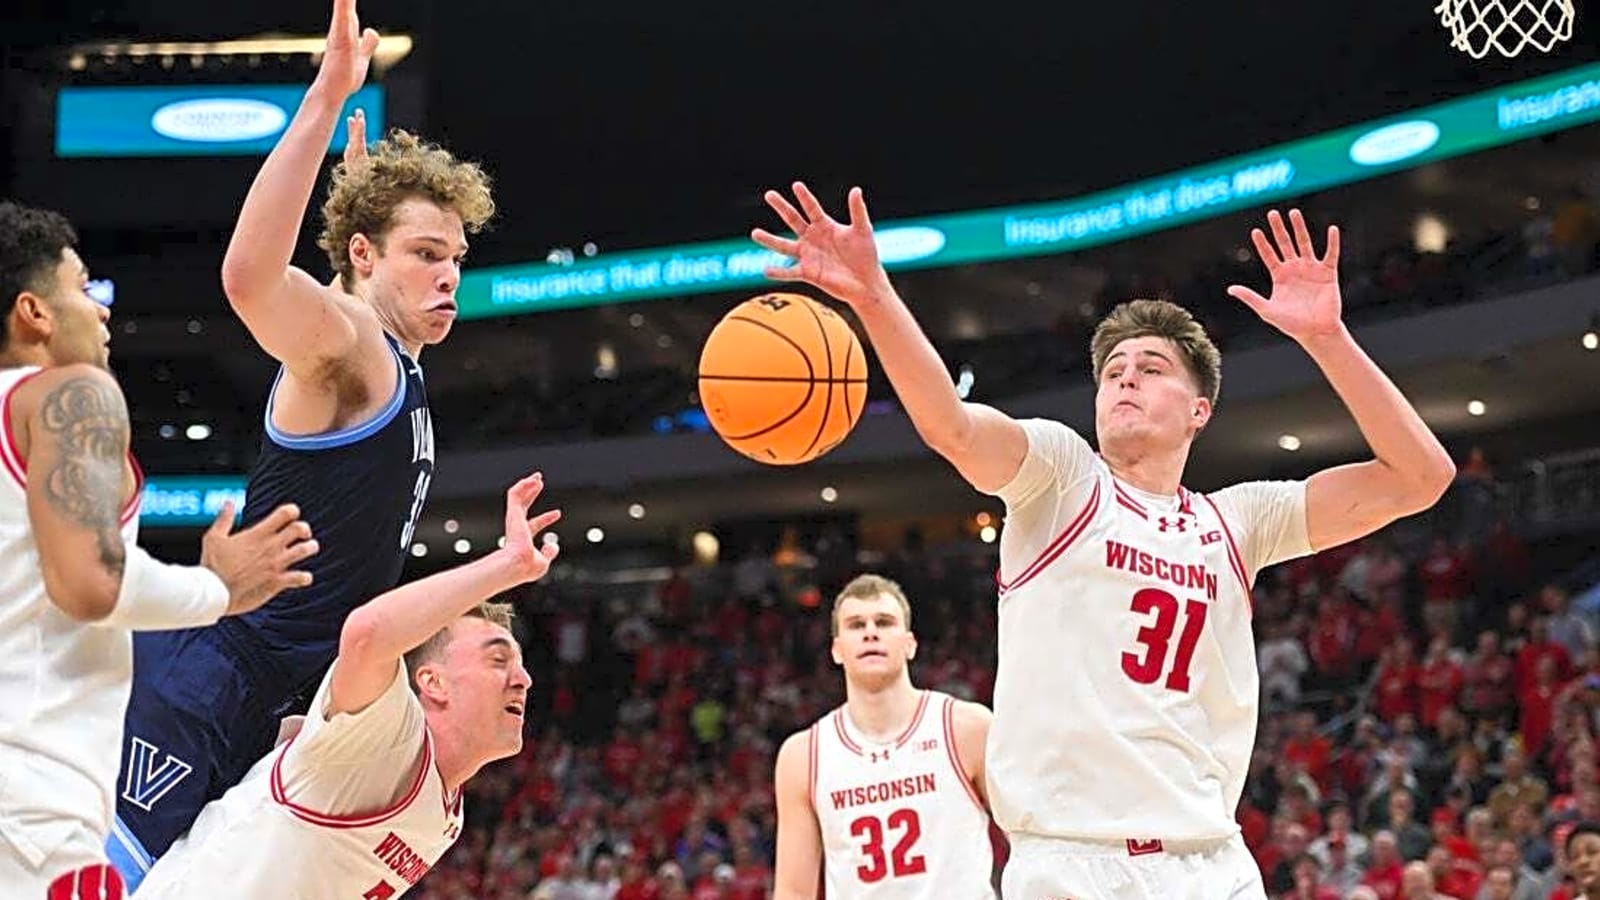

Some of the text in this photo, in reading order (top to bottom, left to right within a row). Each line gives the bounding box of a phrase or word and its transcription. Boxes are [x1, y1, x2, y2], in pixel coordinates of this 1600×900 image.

[1005, 204, 1122, 245] Insurance
[1124, 189, 1171, 224] that
[1174, 178, 1230, 211] does
[492, 270, 607, 304] Insurance
[610, 261, 661, 291] that
[663, 254, 724, 285] does
[1121, 588, 1208, 693] 31
[122, 736, 193, 811] V
[831, 773, 936, 810] WISCONSIN
[850, 808, 927, 884] 32
